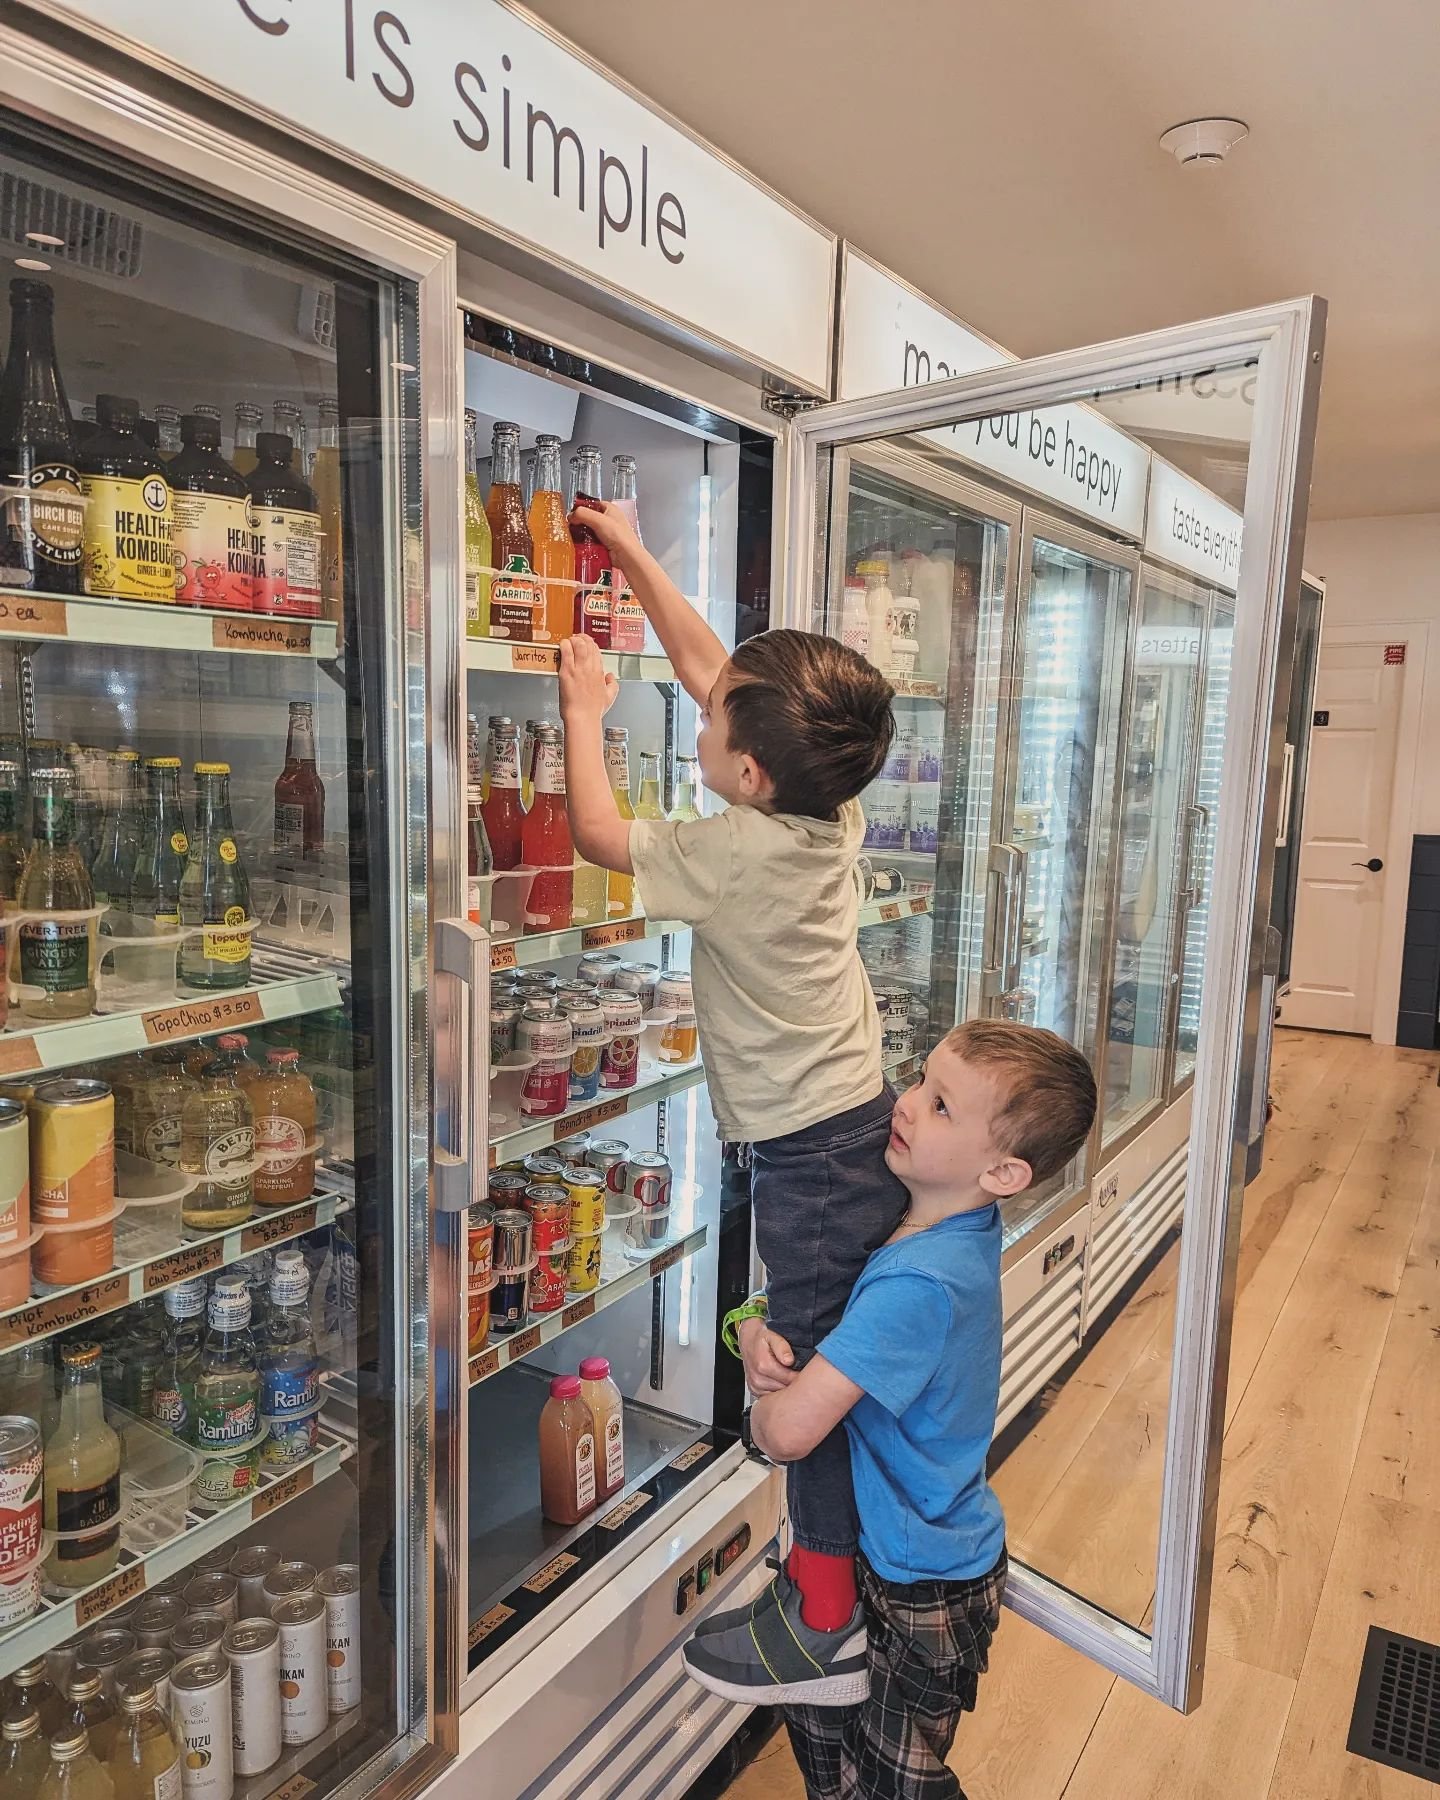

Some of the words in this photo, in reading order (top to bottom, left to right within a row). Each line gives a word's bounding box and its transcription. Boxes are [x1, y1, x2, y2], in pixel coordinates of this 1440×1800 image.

[453, 54, 687, 265] simple
[1029, 409, 1056, 468] be
[1064, 419, 1122, 512] happy
[33, 504, 65, 523] BIRCH
[1172, 498, 1201, 549] taste
[495, 588, 532, 601] JARRITOS
[502, 608, 529, 618] Tamarind
[225, 622, 285, 643] Kombucha
[514, 649, 547, 664] Jarritos
[26, 947, 77, 958] GINGER
[38, 959, 63, 968] ALE
[213, 1000, 251, 1021] $3.50
[0, 1213, 15, 1225] HA
[151, 1255, 181, 1271] Betty
[148, 1273, 170, 1287] Club
[172, 1264, 196, 1278] Soda
[8, 1306, 44, 1329] Pilot
[26, 1303, 99, 1337] Kombucha
[83, 1593, 116, 1620] ginger
[118, 1578, 140, 1598] beer
[184, 1734, 211, 1749] YUZU
